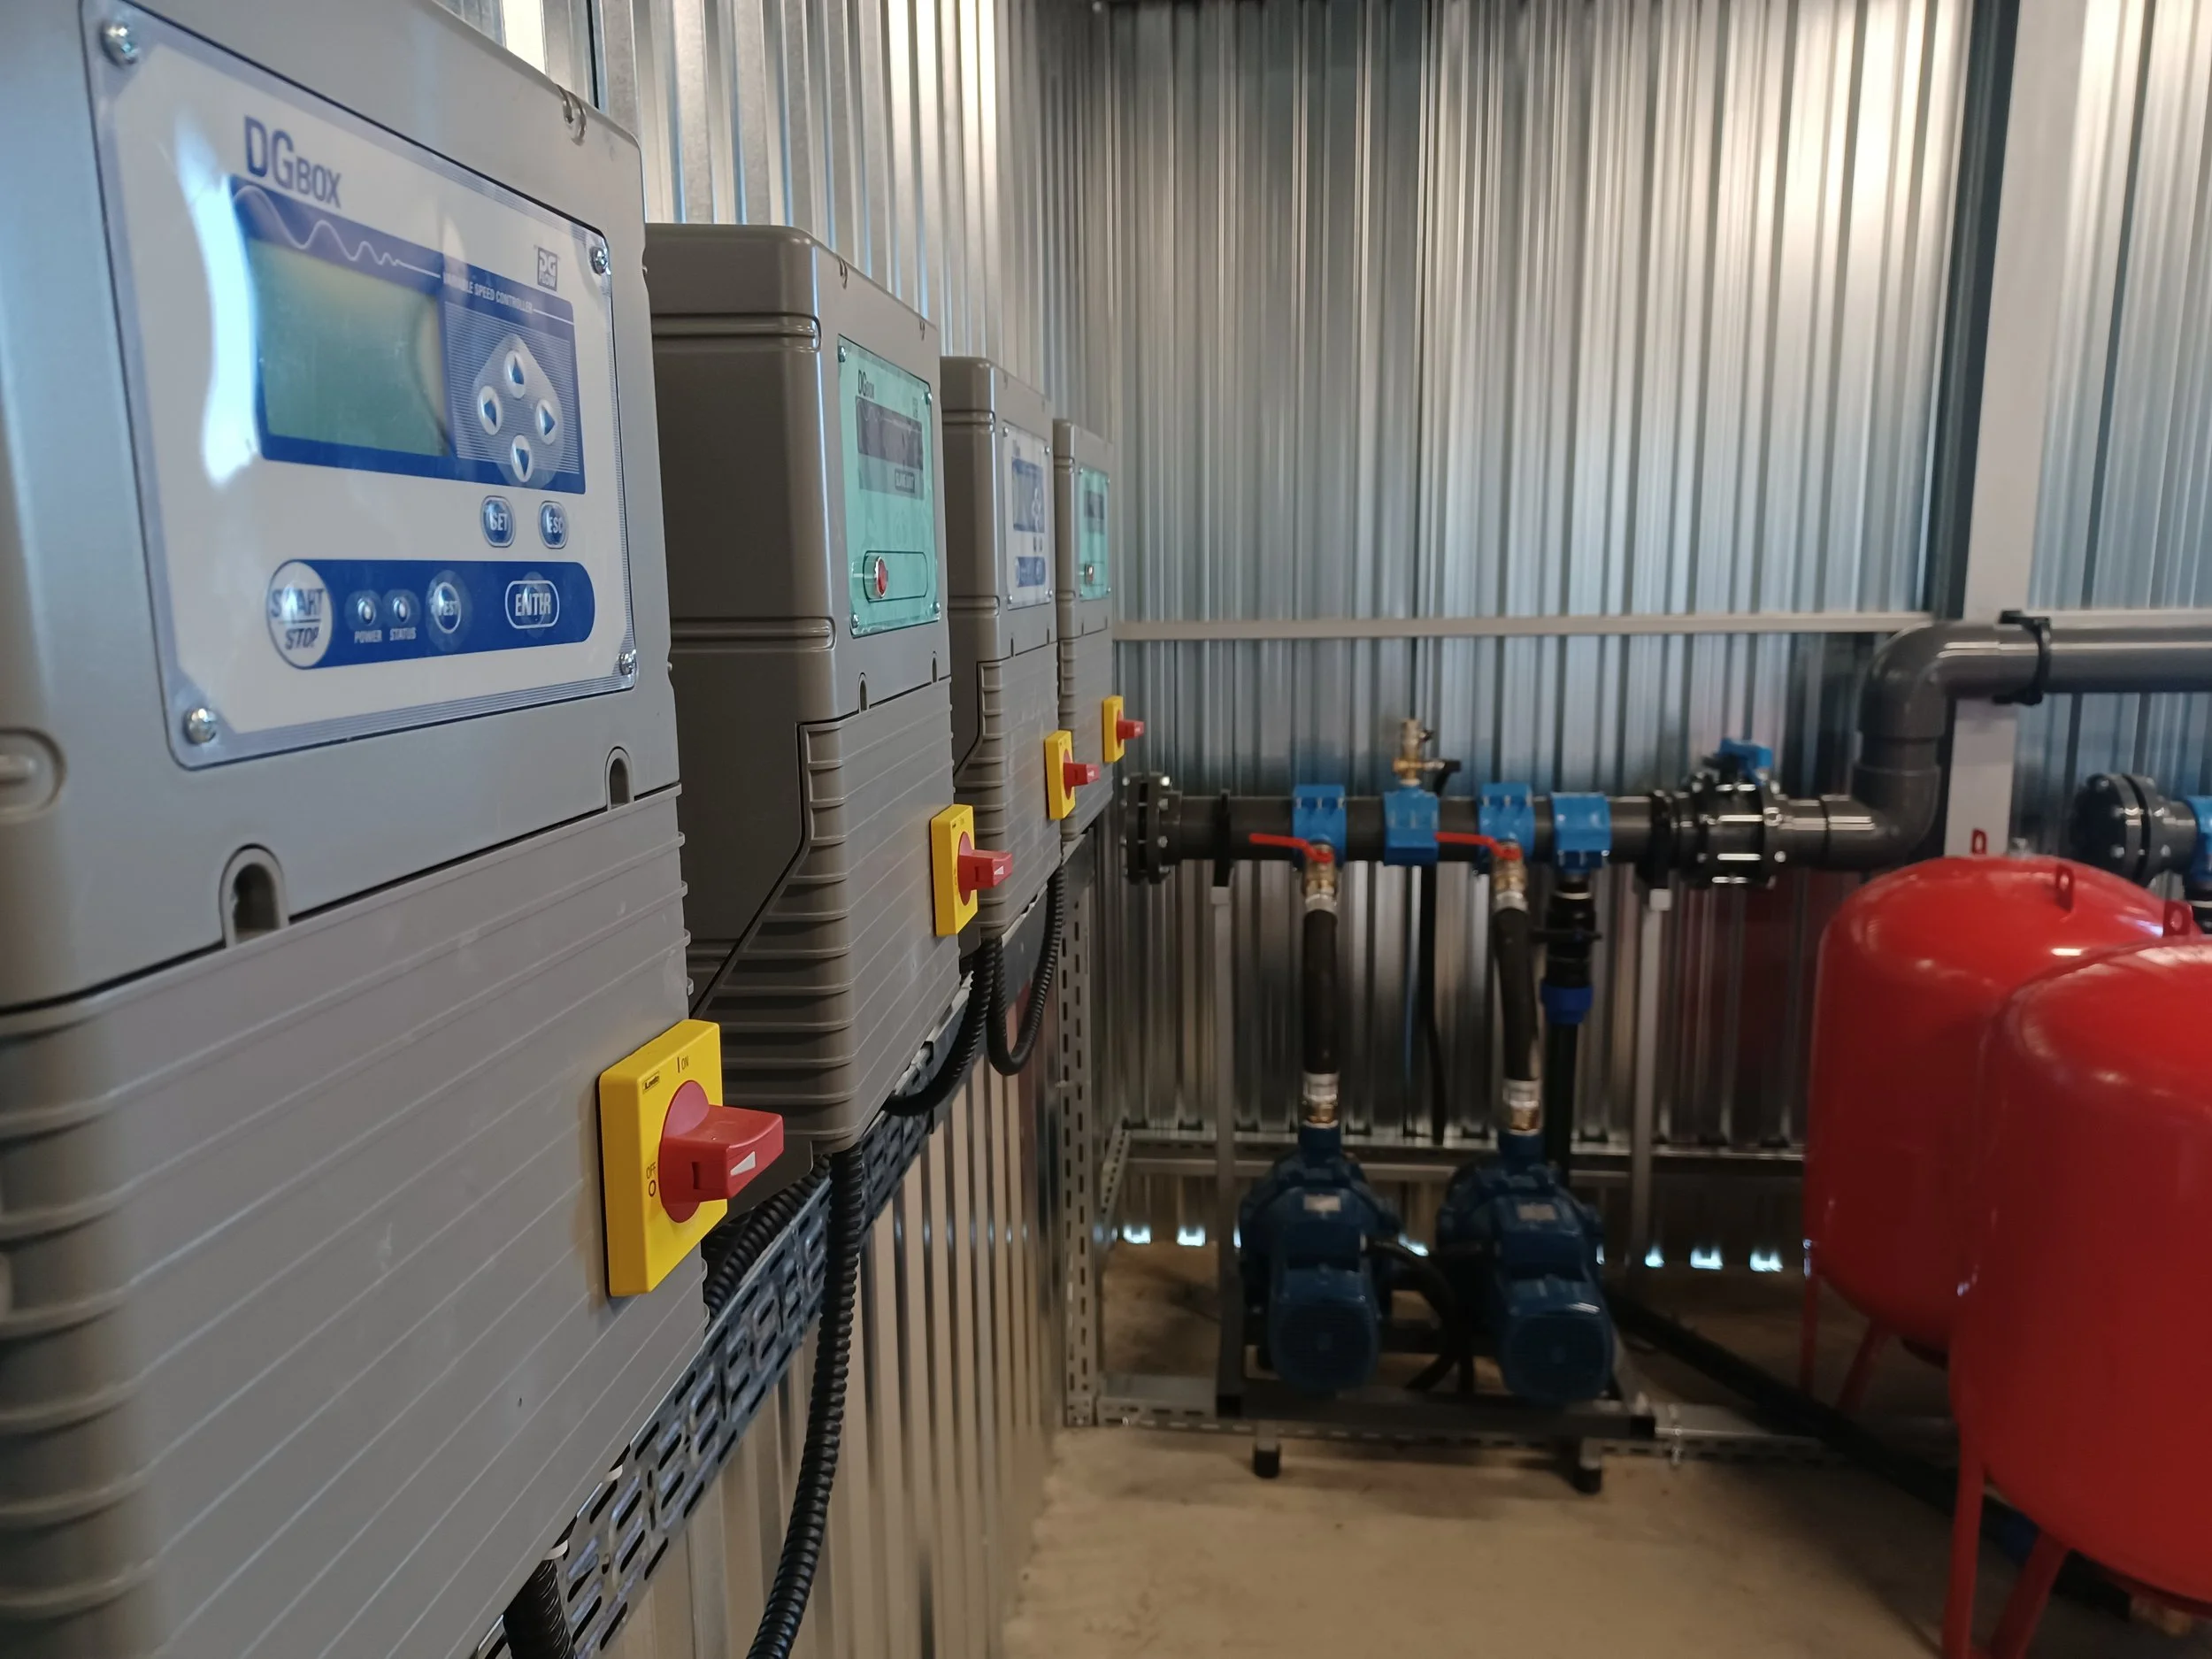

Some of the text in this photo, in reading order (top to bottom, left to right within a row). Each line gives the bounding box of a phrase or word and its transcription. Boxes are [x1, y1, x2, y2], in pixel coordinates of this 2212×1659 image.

[474, 282, 495, 301] SPEED
[495, 290, 533, 314] CONTROLLER
[489, 513, 508, 531] SET
[546, 516, 564, 534] ESC
[515, 593, 551, 617] ENTER
[285, 627, 319, 650] STOP
[354, 629, 382, 643] POWER
[389, 627, 417, 641] STATUS
